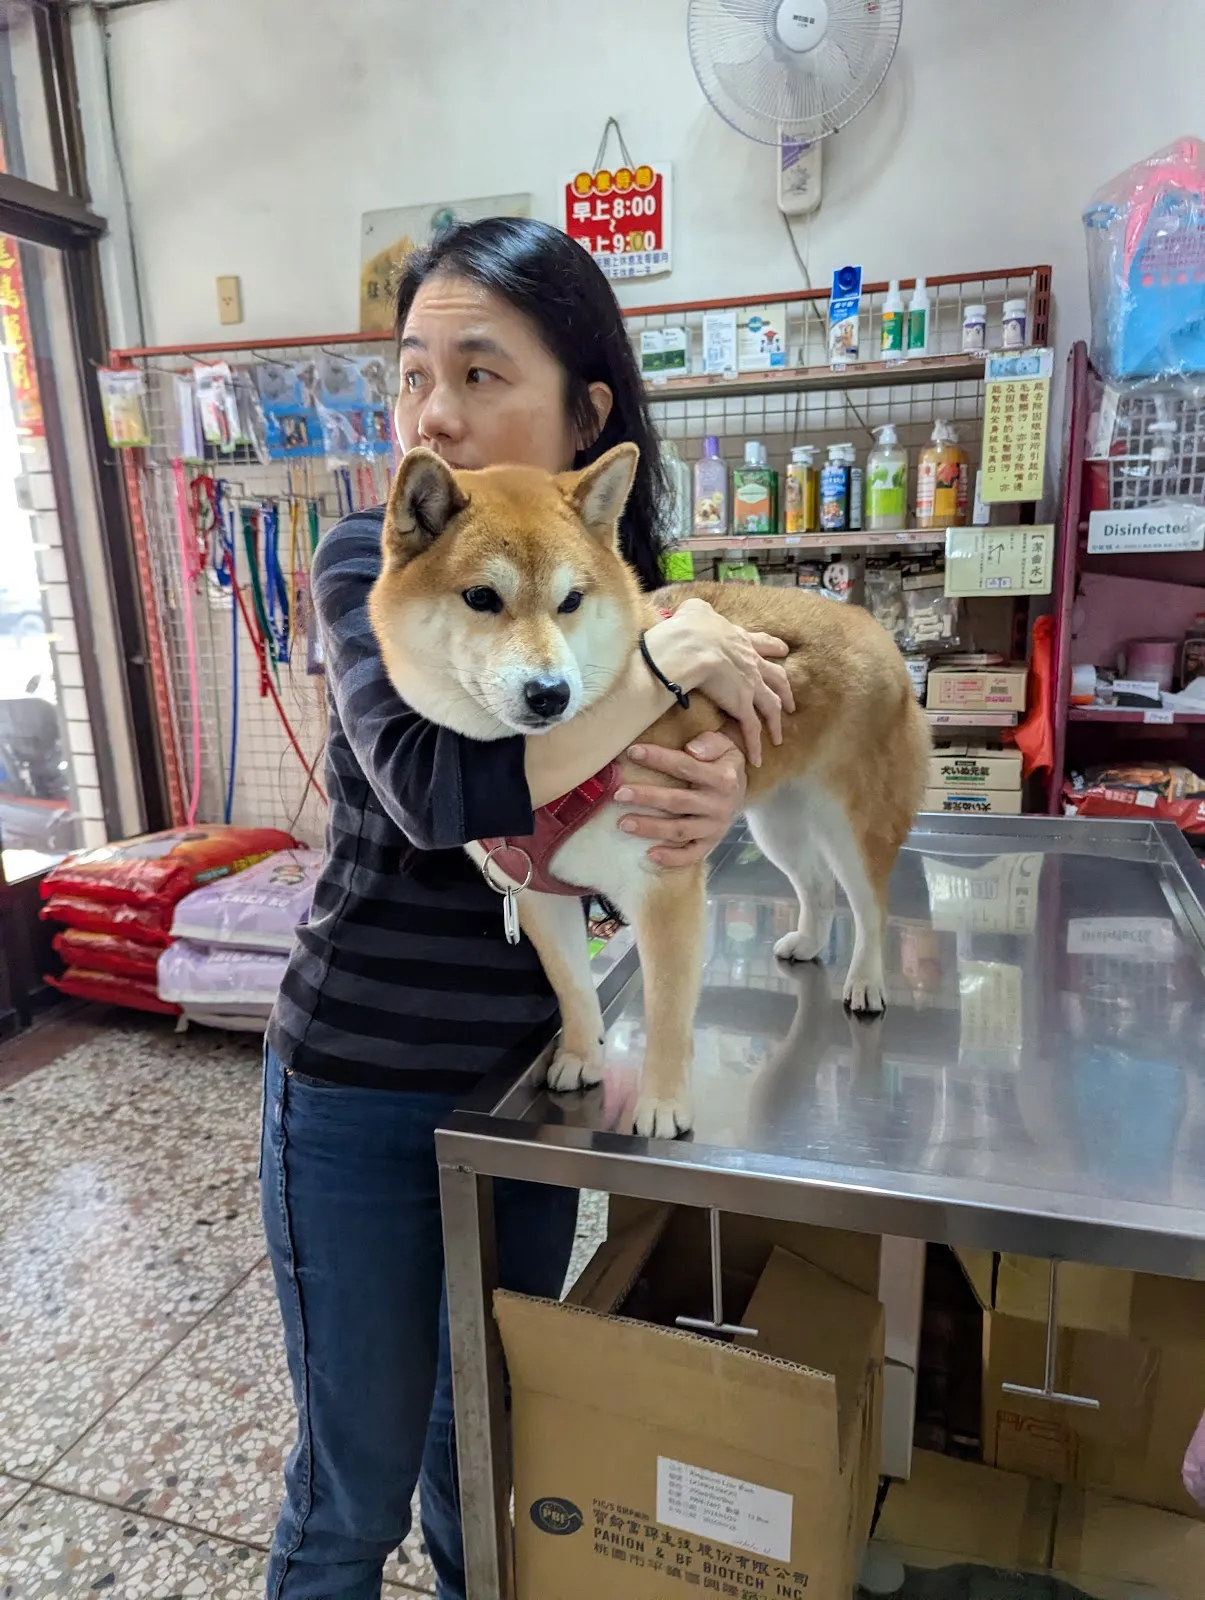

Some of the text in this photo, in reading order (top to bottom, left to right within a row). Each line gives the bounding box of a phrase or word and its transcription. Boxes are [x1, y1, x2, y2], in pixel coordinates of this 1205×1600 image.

[594, 1527, 802, 1600] PANION & BF BIOTECH INC
